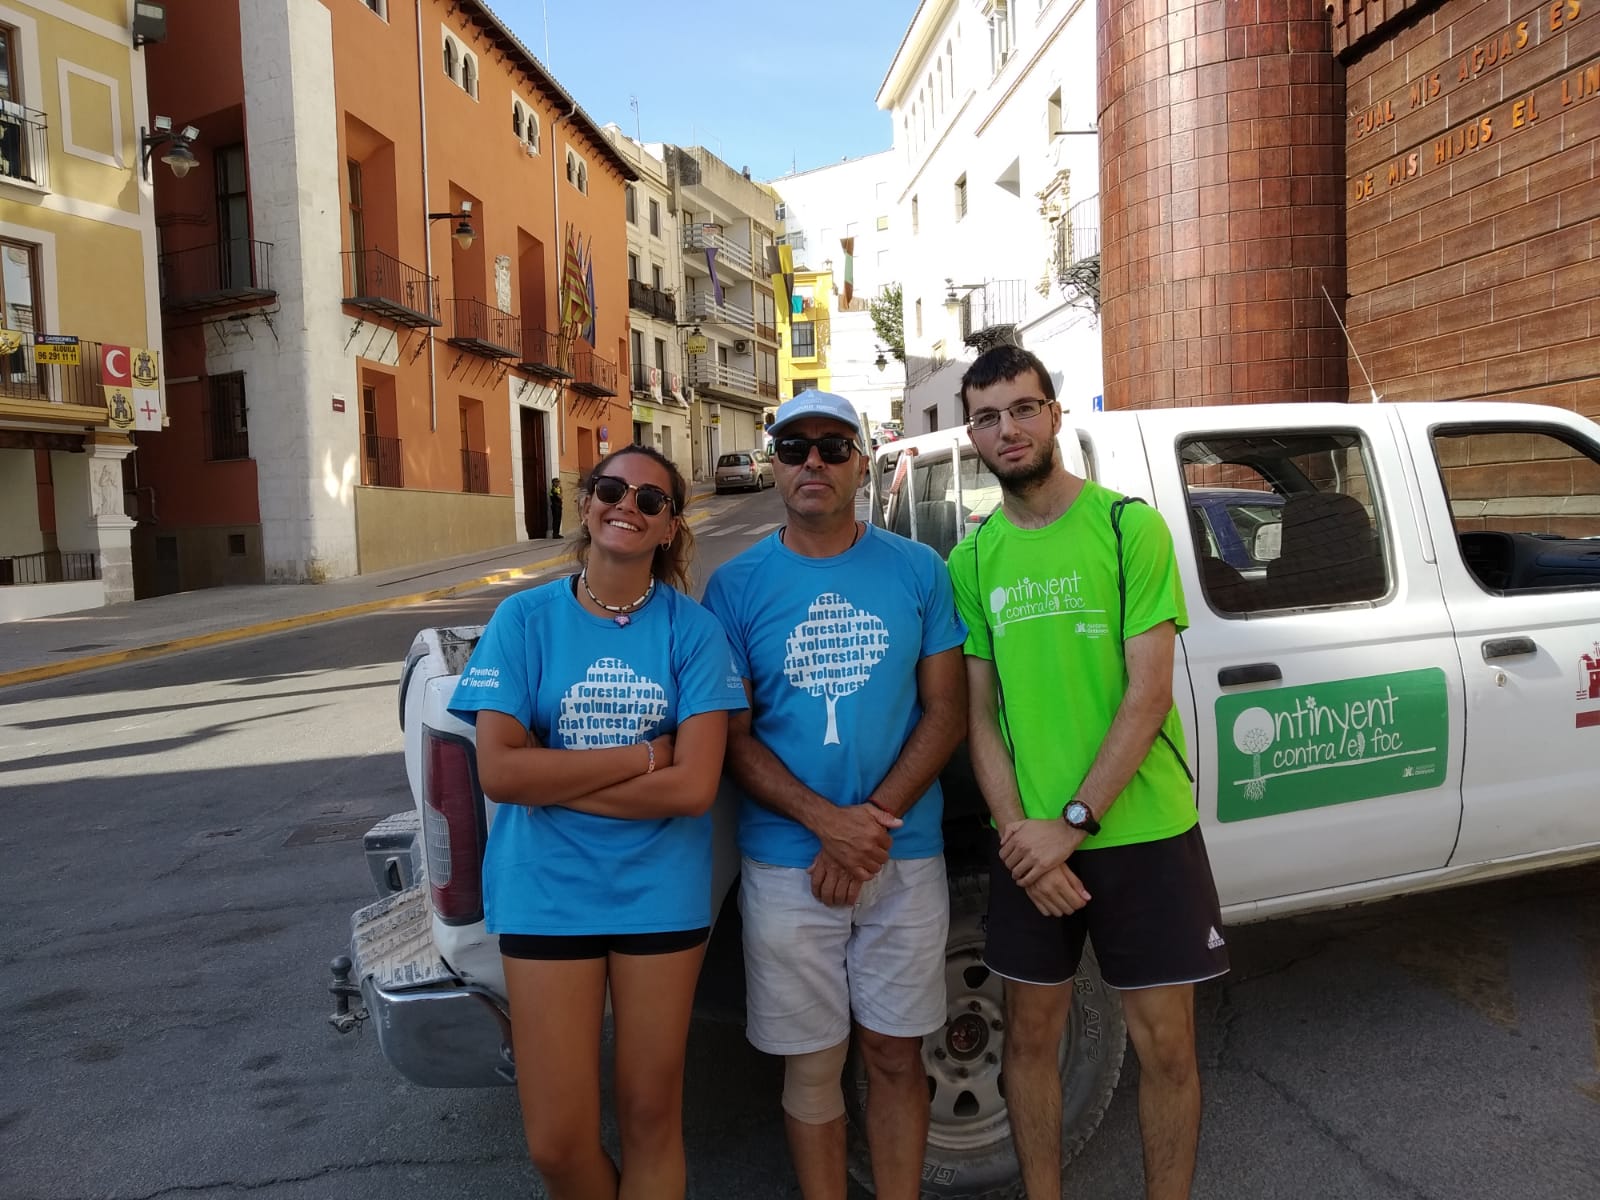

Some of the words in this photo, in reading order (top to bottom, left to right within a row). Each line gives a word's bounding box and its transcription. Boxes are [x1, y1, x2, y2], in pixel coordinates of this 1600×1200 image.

[1408, 74, 1441, 109] MIS
[1458, 21, 1528, 82] AGUAS
[1550, 0, 1581, 32] ES
[1355, 174, 1374, 200] DE
[1389, 153, 1418, 186] MIS
[1434, 118, 1493, 165] HIJOS
[1513, 94, 1539, 129] EL
[38, 352, 47, 360] 96
[48, 352, 60, 361] 291
[1006, 600, 1045, 618] contra
[1064, 594, 1086, 609] foc
[1273, 740, 1337, 769] contra
[1370, 728, 1403, 753] foc
